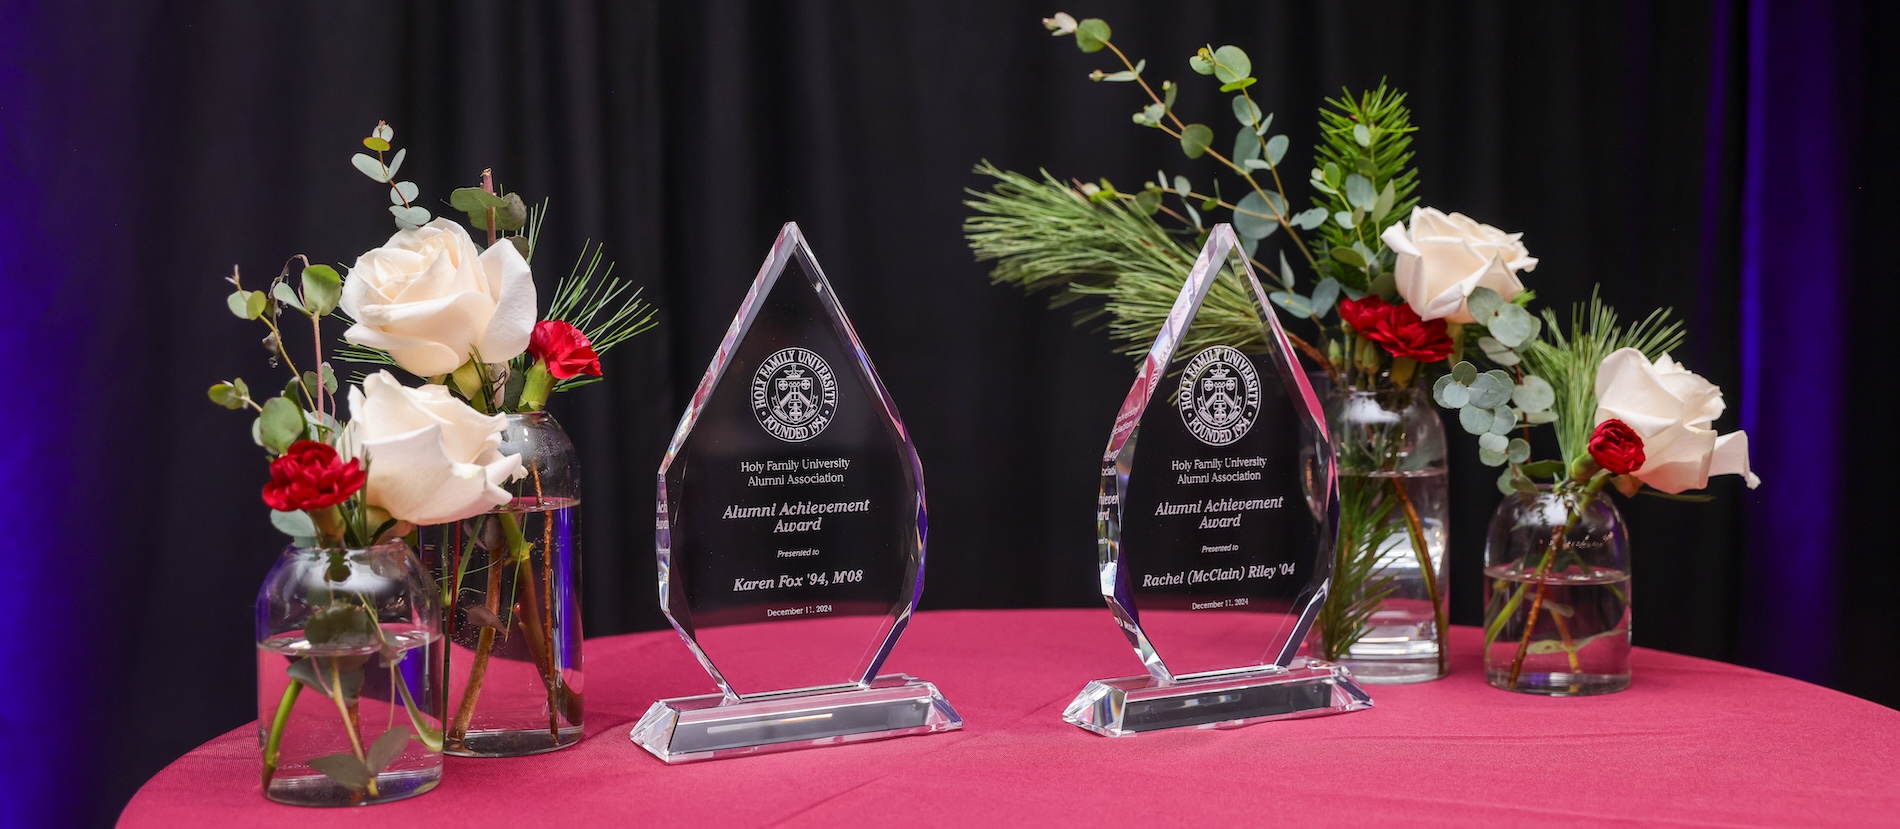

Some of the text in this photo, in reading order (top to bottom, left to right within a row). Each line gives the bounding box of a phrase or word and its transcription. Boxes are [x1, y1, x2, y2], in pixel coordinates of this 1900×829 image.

[754, 350, 835, 410] HOLY FAMILY UNIVERSITY
[1181, 377, 1193, 411] HOLY
[1187, 349, 1221, 378] FAMILY
[1223, 349, 1258, 408] UNIVERSITY
[763, 414, 828, 439] FOUNDED 1954
[1189, 416, 1251, 442] FOUNDED 1954
[741, 458, 850, 473] Holy Family University
[1172, 456, 1267, 471] Holy Family University
[748, 472, 843, 486] Alumni Association
[1178, 470, 1261, 484] Alumni Association
[723, 500, 870, 519] Alumni Achievement
[1155, 497, 1283, 515] Alumni Achievement
[774, 517, 822, 532] Award
[1199, 514, 1241, 529] Award
[734, 578, 774, 591] Karen
[778, 575, 803, 587] Fox
[806, 572, 829, 587] '94,
[1143, 563, 1295, 587] Rachel (McClain) Riley '04
[768, 608, 803, 616] December
[1192, 601, 1223, 609] December
